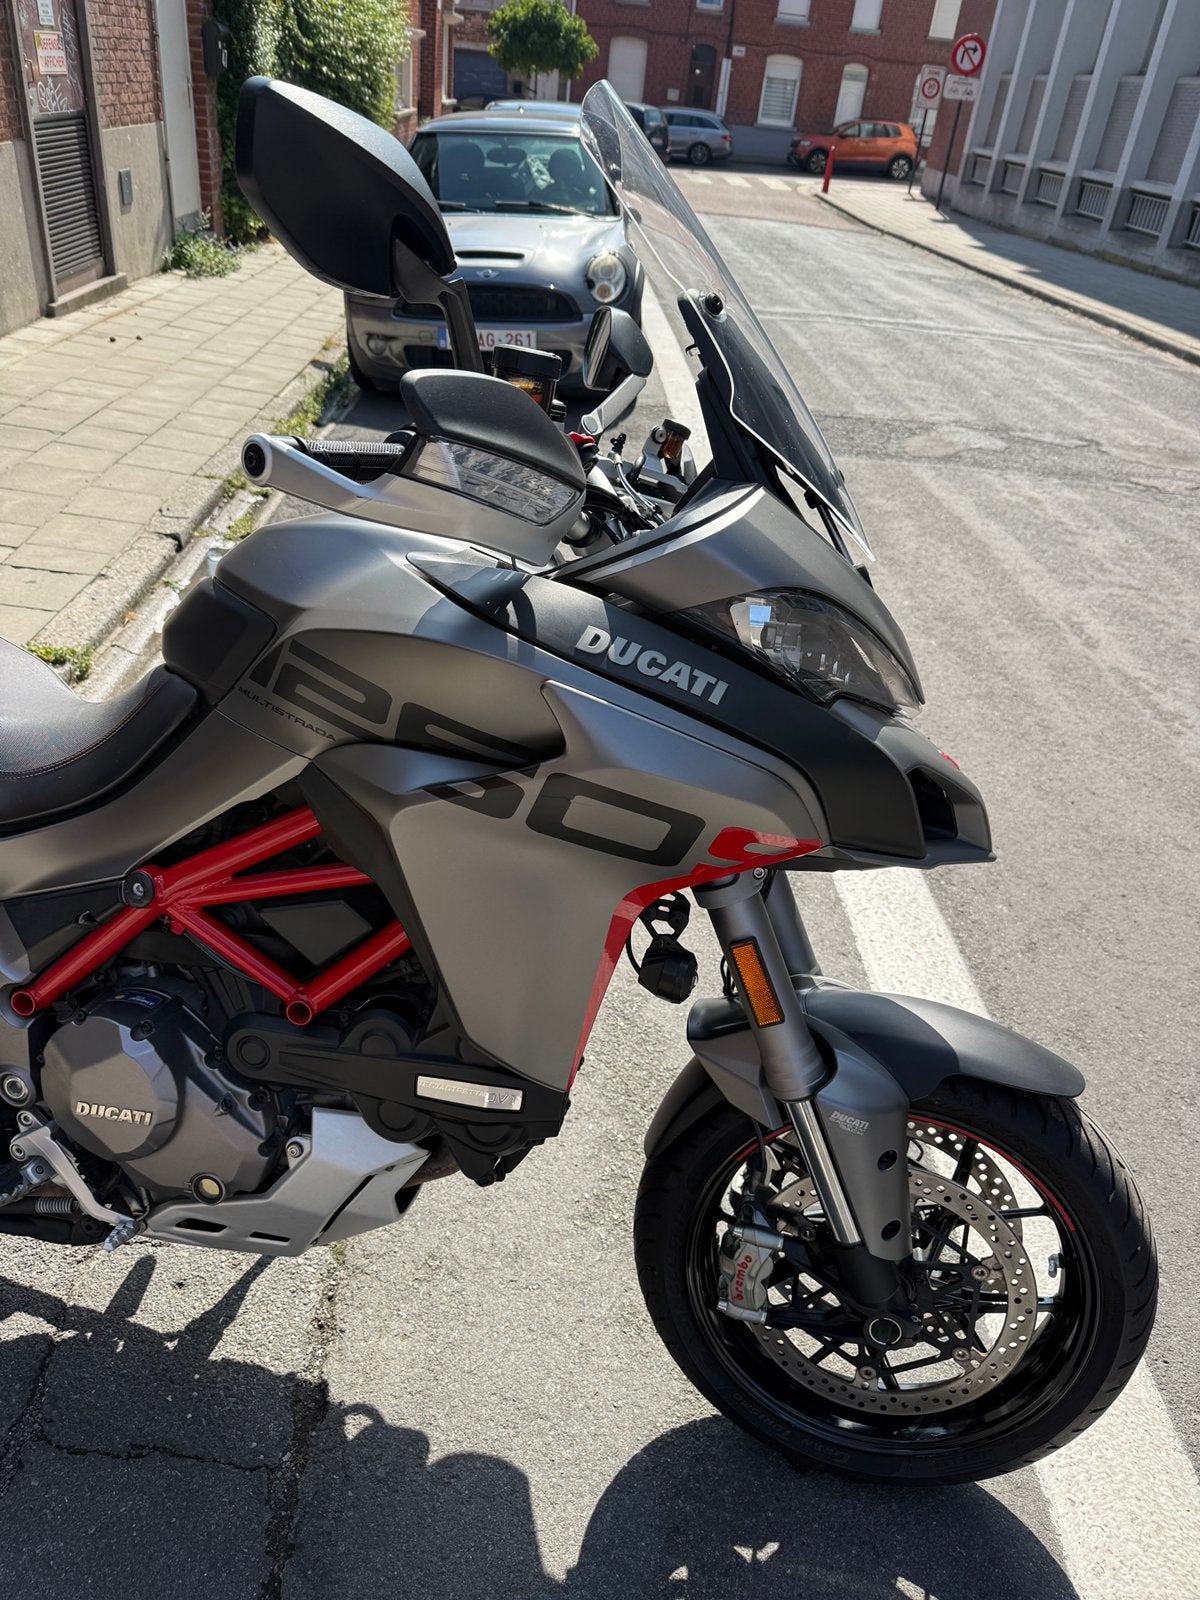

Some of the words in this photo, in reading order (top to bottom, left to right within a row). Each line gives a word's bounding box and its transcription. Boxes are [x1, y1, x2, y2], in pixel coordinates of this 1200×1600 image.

[575, 625, 729, 705] DUCATI
[238, 685, 337, 742] MULTISTRADA
[75, 1101, 153, 1126] DUCATI
[831, 1110, 870, 1130] DUCATI
[734, 1255, 753, 1301] brembo
